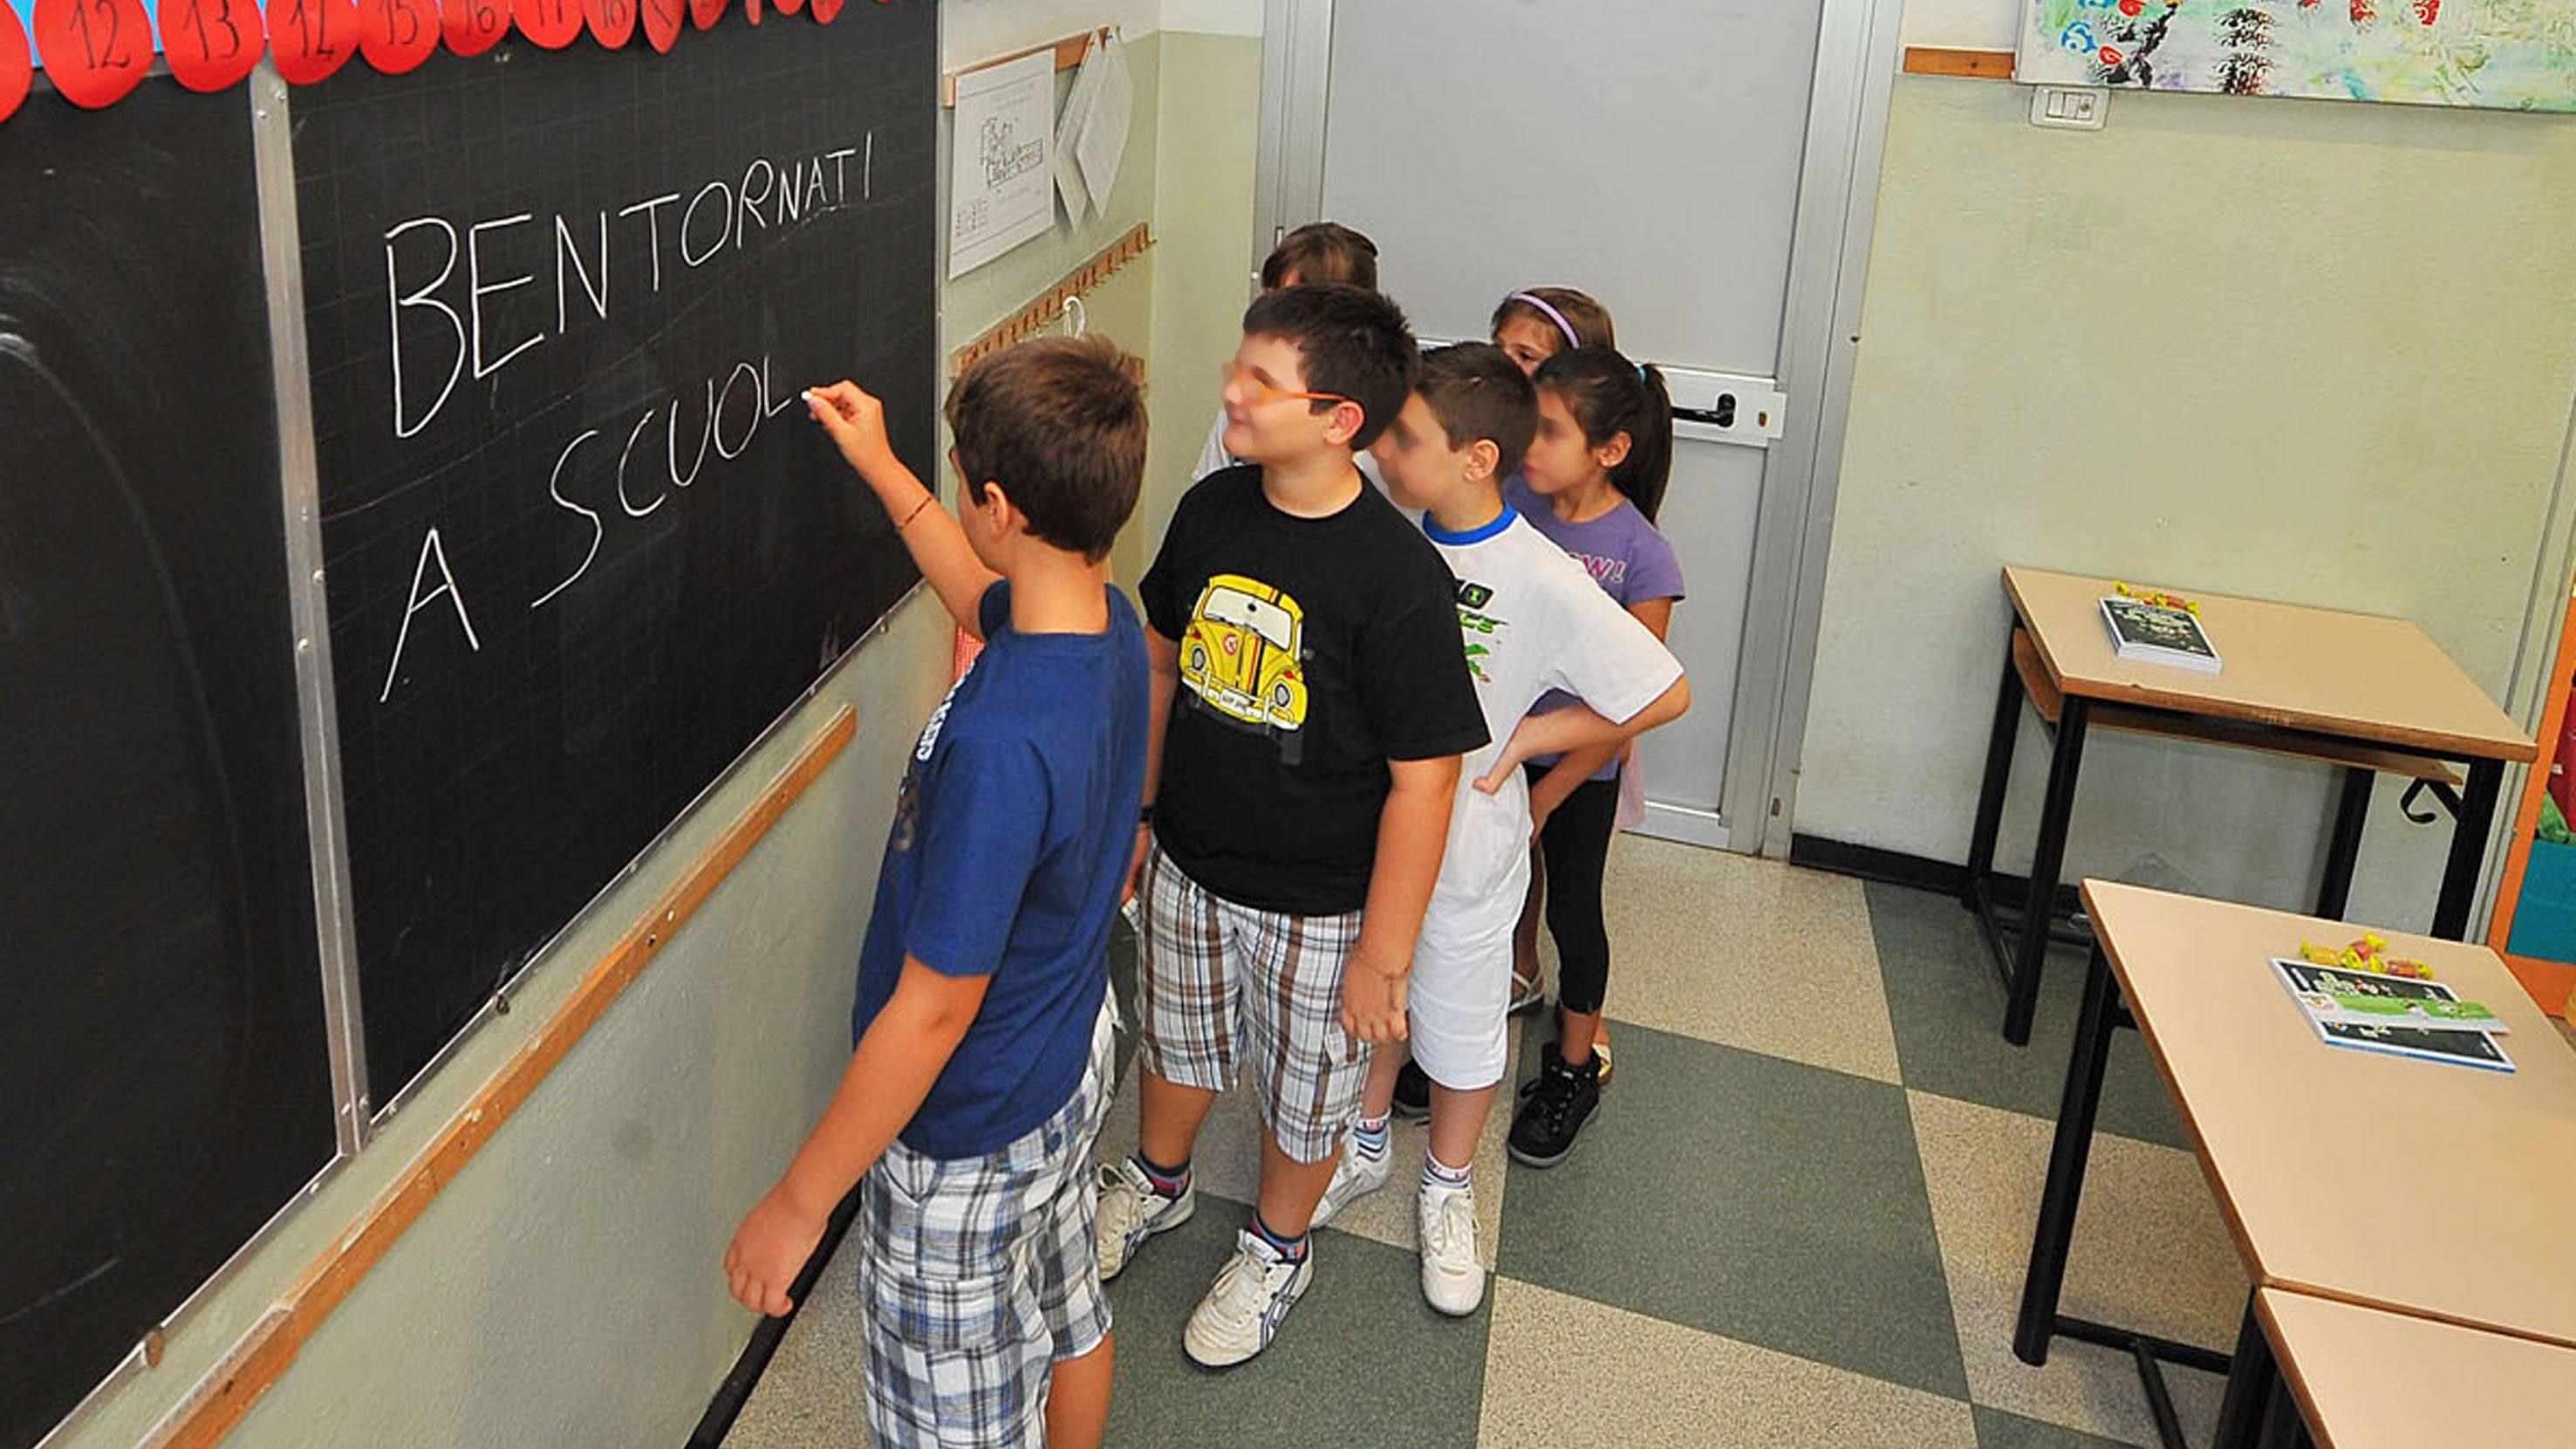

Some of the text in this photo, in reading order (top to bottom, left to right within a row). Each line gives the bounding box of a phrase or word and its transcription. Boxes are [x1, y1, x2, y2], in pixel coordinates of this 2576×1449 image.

[69, 0, 131, 70] 12
[181, 0, 241, 62] 13
[380, 0, 420, 45] 15
[385, 131, 873, 438] BENTORNATI
[379, 354, 793, 704] A SCUOL
[1569, 551, 1628, 584] W!
